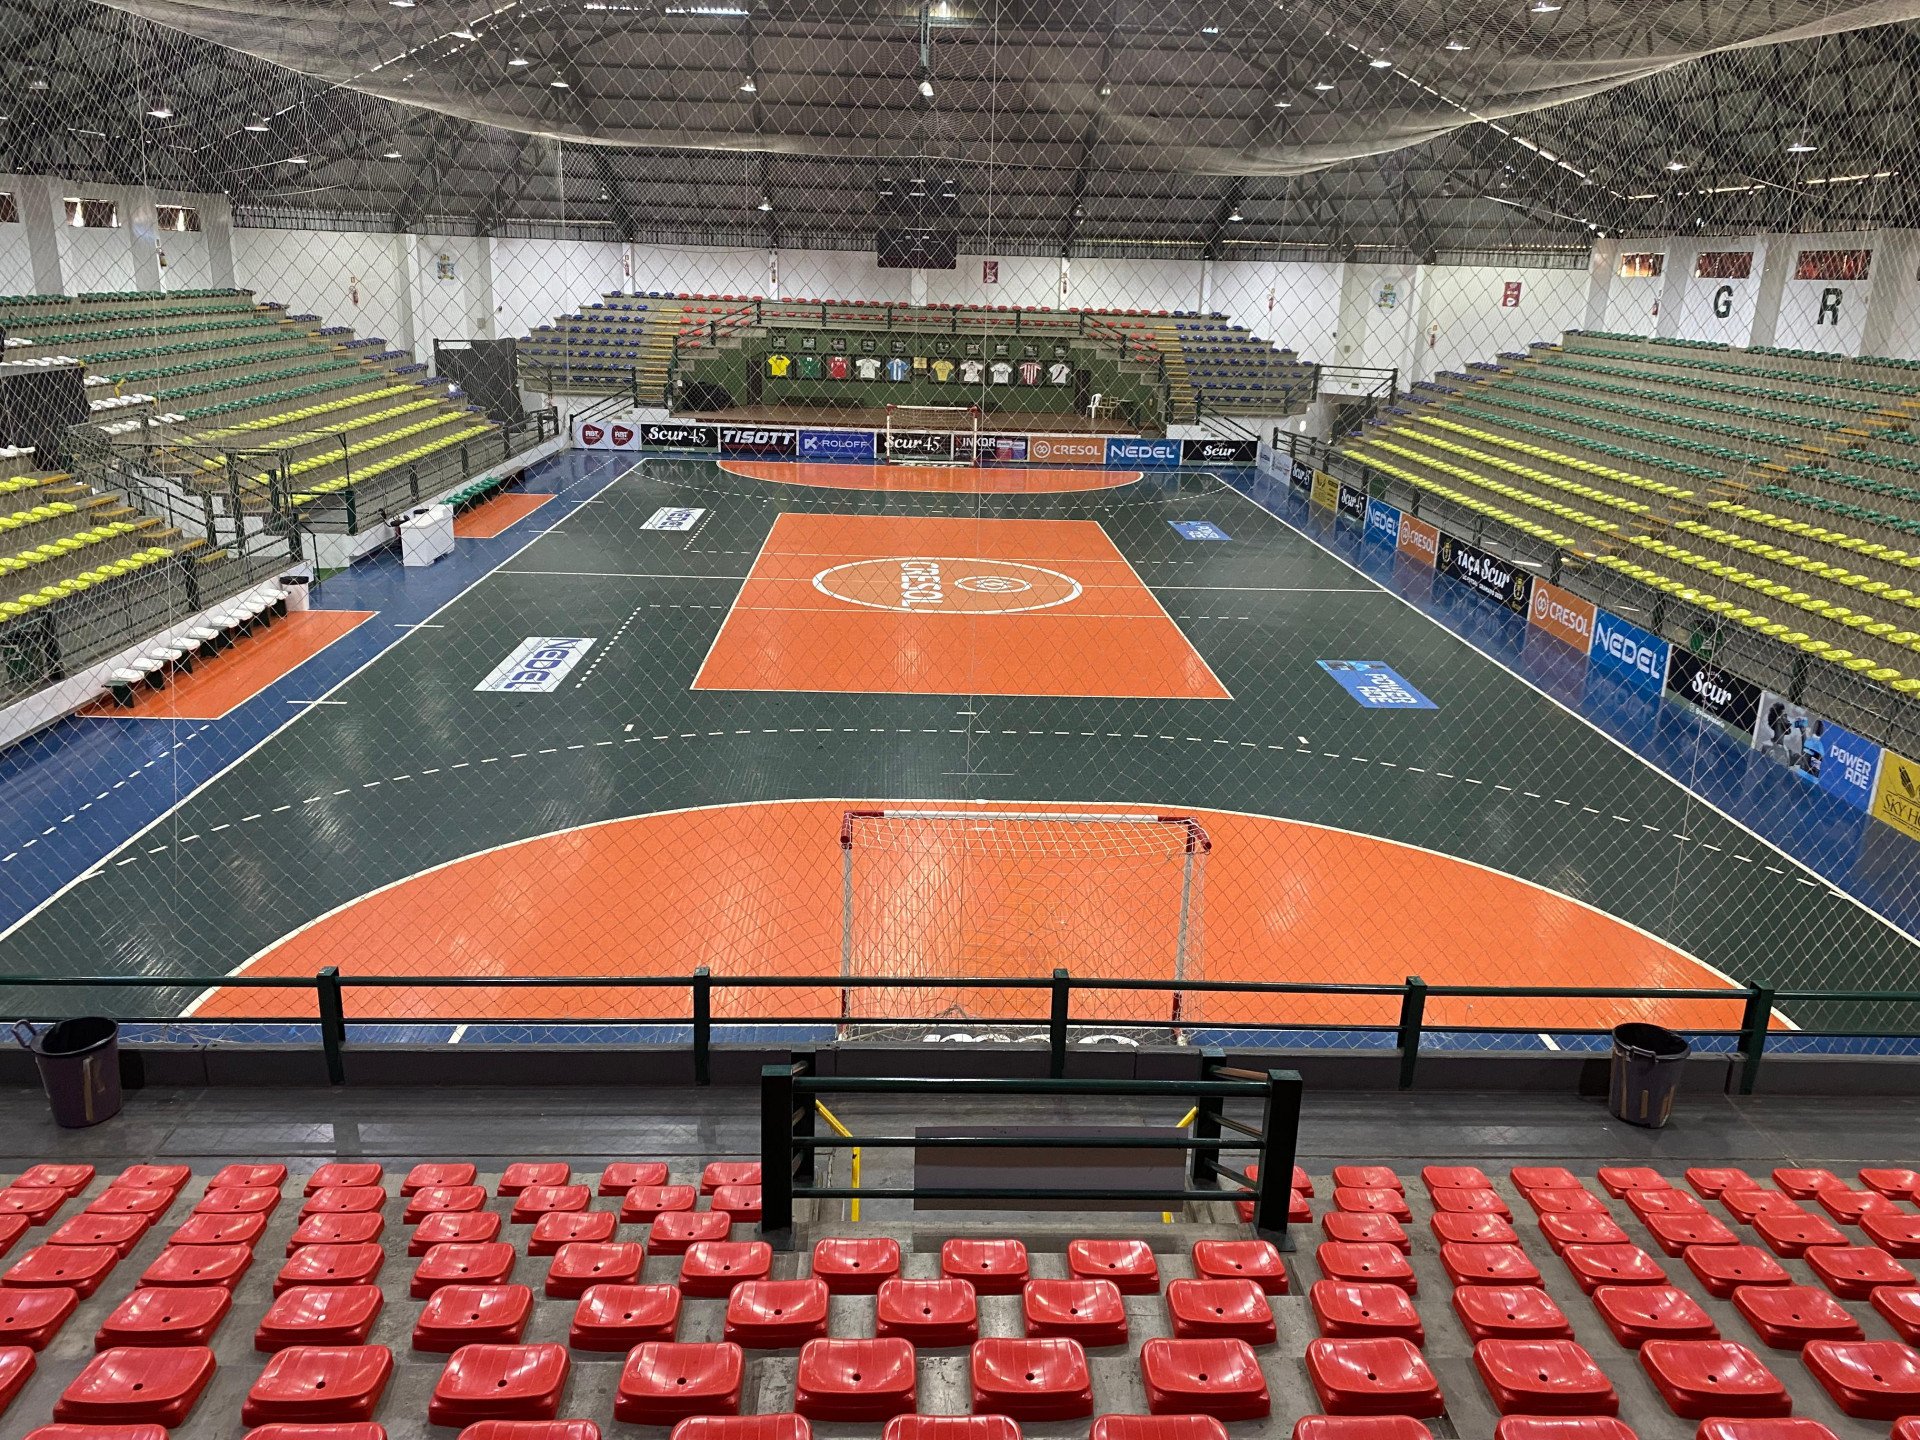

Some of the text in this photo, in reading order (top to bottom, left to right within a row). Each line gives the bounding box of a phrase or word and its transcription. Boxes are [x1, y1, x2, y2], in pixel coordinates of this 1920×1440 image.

[1714, 285, 1843, 325] G R
[648, 427, 706, 443] Scur 45
[723, 430, 795, 445] TISOTT
[822, 439, 867, 448] ROLOFF
[884, 436, 941, 451] Scur 45
[1053, 445, 1100, 455] CRESOL
[1110, 445, 1175, 458] NEDEL
[1203, 445, 1235, 456] Scur
[1368, 506, 1397, 536] NEDEL
[1410, 530, 1434, 554] CRESOL
[1458, 550, 1509, 588] TAÇA Scur
[901, 562, 943, 607] CRESOL
[1550, 602, 1589, 637] CRESOL
[503, 639, 583, 689] NEDEL
[1595, 623, 1660, 679] NEDEL
[1692, 671, 1731, 705] Scur
[1830, 745, 1871, 776] POWER
[1844, 769, 1869, 790] ADE
